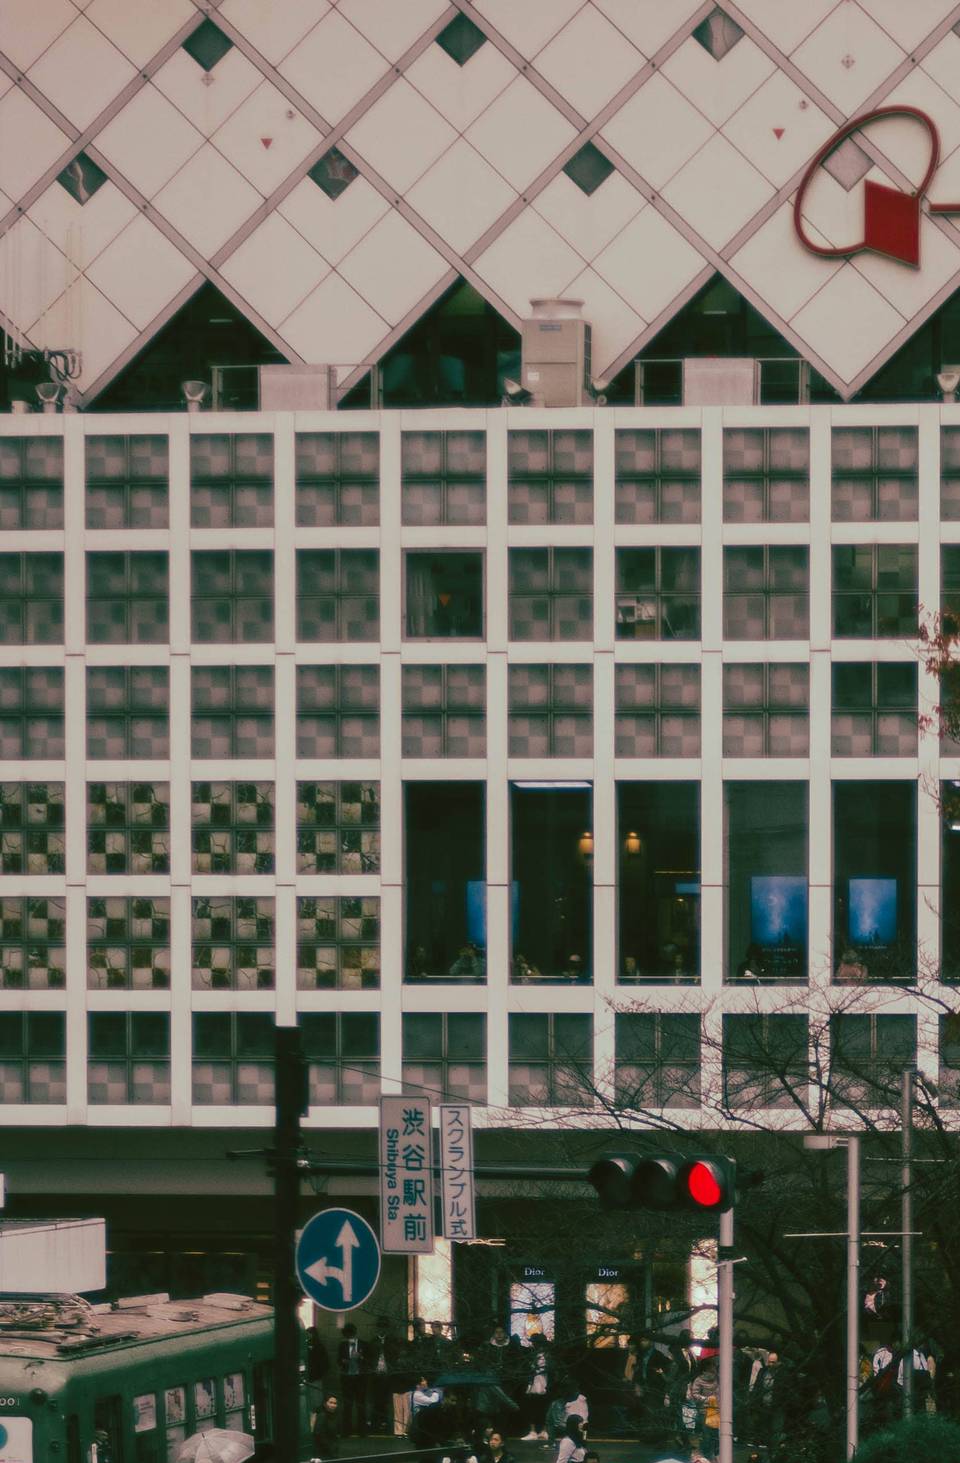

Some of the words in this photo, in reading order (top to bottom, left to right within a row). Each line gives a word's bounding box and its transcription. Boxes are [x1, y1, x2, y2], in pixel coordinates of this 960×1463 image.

[385, 1128, 399, 1190] Shibuya
[402, 1107, 427, 1242] 渋谷駅前
[447, 1110, 468, 1236] スクランブル式
[387, 1196, 400, 1226] Sta.
[524, 1267, 545, 1277] Dior
[598, 1267, 619, 1278] Dior
